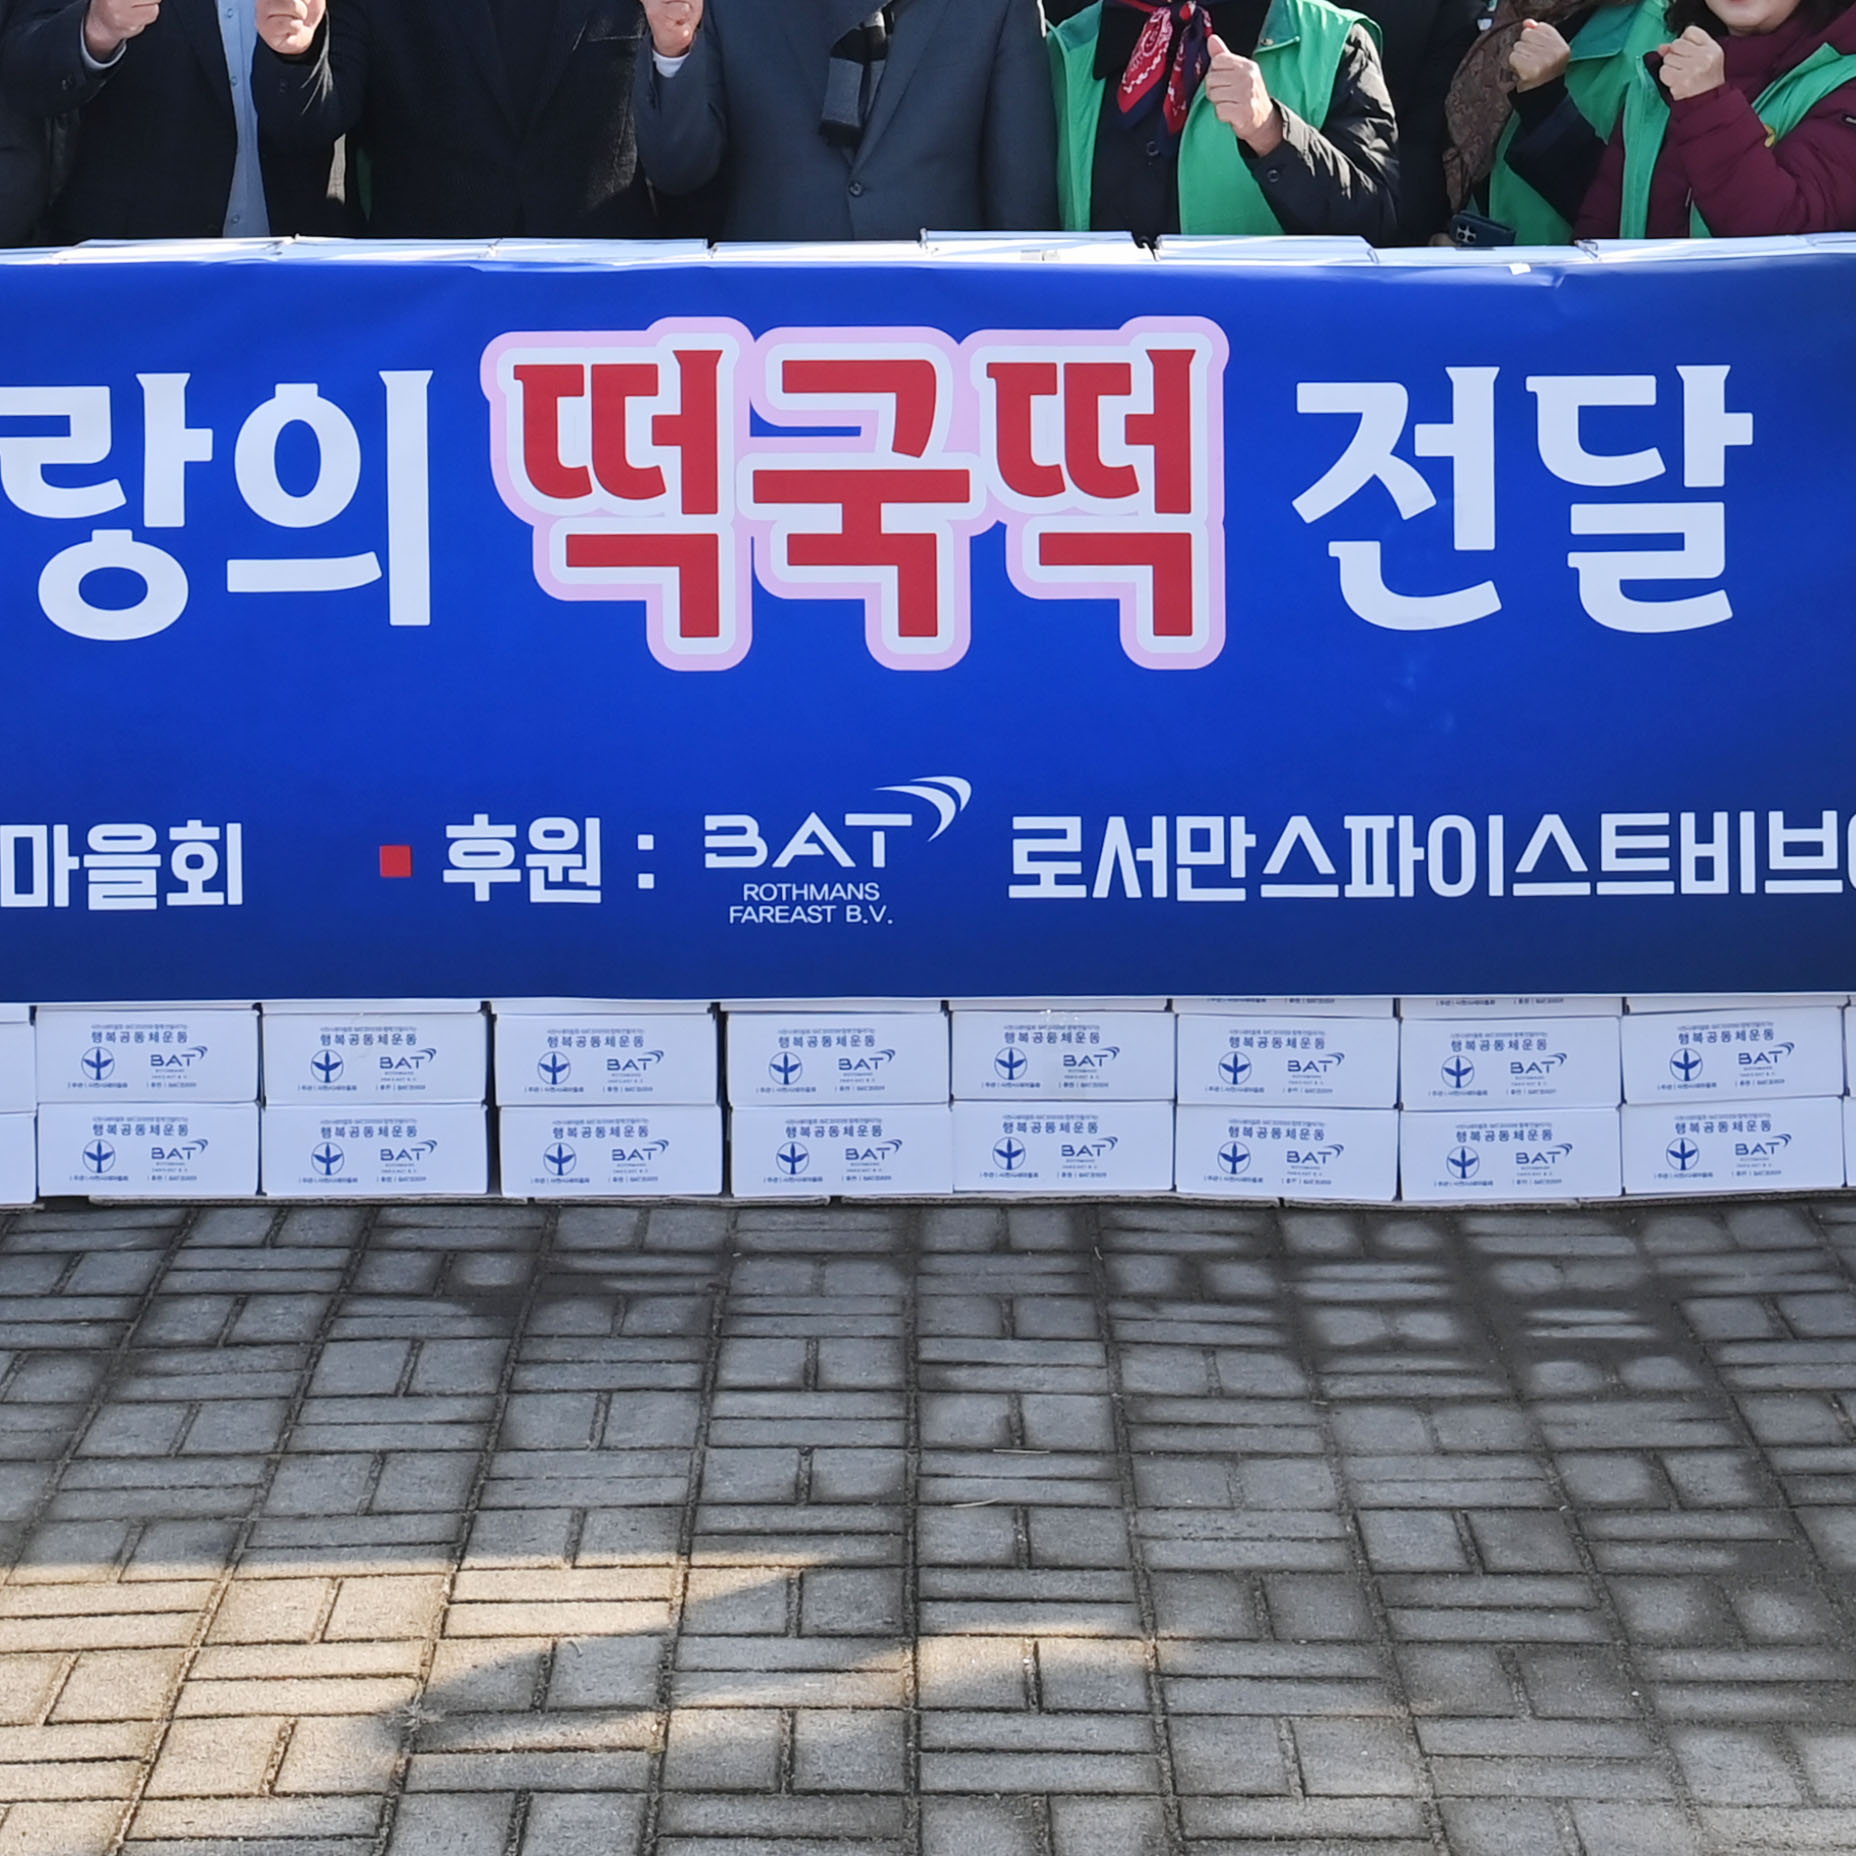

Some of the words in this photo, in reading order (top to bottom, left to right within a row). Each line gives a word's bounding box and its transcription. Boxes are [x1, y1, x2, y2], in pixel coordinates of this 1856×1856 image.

[510, 346, 1199, 640] 떡국떡
[1293, 366, 1752, 632] 전달
[704, 812, 913, 868] BAT
[444, 815, 601, 904] 후원
[742, 881, 881, 902] ROTHMANS
[728, 904, 836, 925] FAREAST
[845, 904, 894, 925] B.V.
[90, 1029, 190, 1044] 행복공동체운동
[319, 1032, 419, 1047] 행복공동체운동
[546, 1034, 646, 1049] 행복공동체운동
[777, 1034, 877, 1049] 행복공동체운동
[1002, 1030, 1102, 1045] 행복공동체운동
[1227, 1035, 1327, 1050] 행복공동체운동
[1449, 1038, 1549, 1053] 행복공동체운동
[1677, 1029, 1777, 1044] 행복공동체운동
[150, 1050, 196, 1068] BAT
[379, 1052, 425, 1070] BAT
[606, 1054, 652, 1072] BAT
[838, 1053, 884, 1071] BAT
[1062, 1050, 1108, 1068] BAT
[1288, 1056, 1331, 1073] BAT
[1737, 1047, 1783, 1065] BAT
[1509, 1057, 1555, 1075] BAT
[91, 1122, 191, 1137] 행복공동체운동
[319, 1124, 419, 1139] 행복공동체운동
[551, 1124, 651, 1139] 행복공동체운동
[784, 1124, 884, 1139] 행복공동체운동
[1001, 1120, 1101, 1135] 행복공동체운동
[1227, 1125, 1327, 1140] 행복공동체운동
[1454, 1128, 1554, 1143] 행복공동체운동
[1674, 1119, 1774, 1134] 행복공동체운동
[150, 1143, 196, 1161] BAT
[379, 1144, 425, 1162] BAT
[611, 1144, 657, 1162] BAT
[844, 1143, 890, 1161] BAT
[1060, 1140, 1106, 1158] BAT
[1287, 1147, 1330, 1164] BAT
[1515, 1147, 1561, 1165] BAT
[1734, 1138, 1780, 1156] BAT
